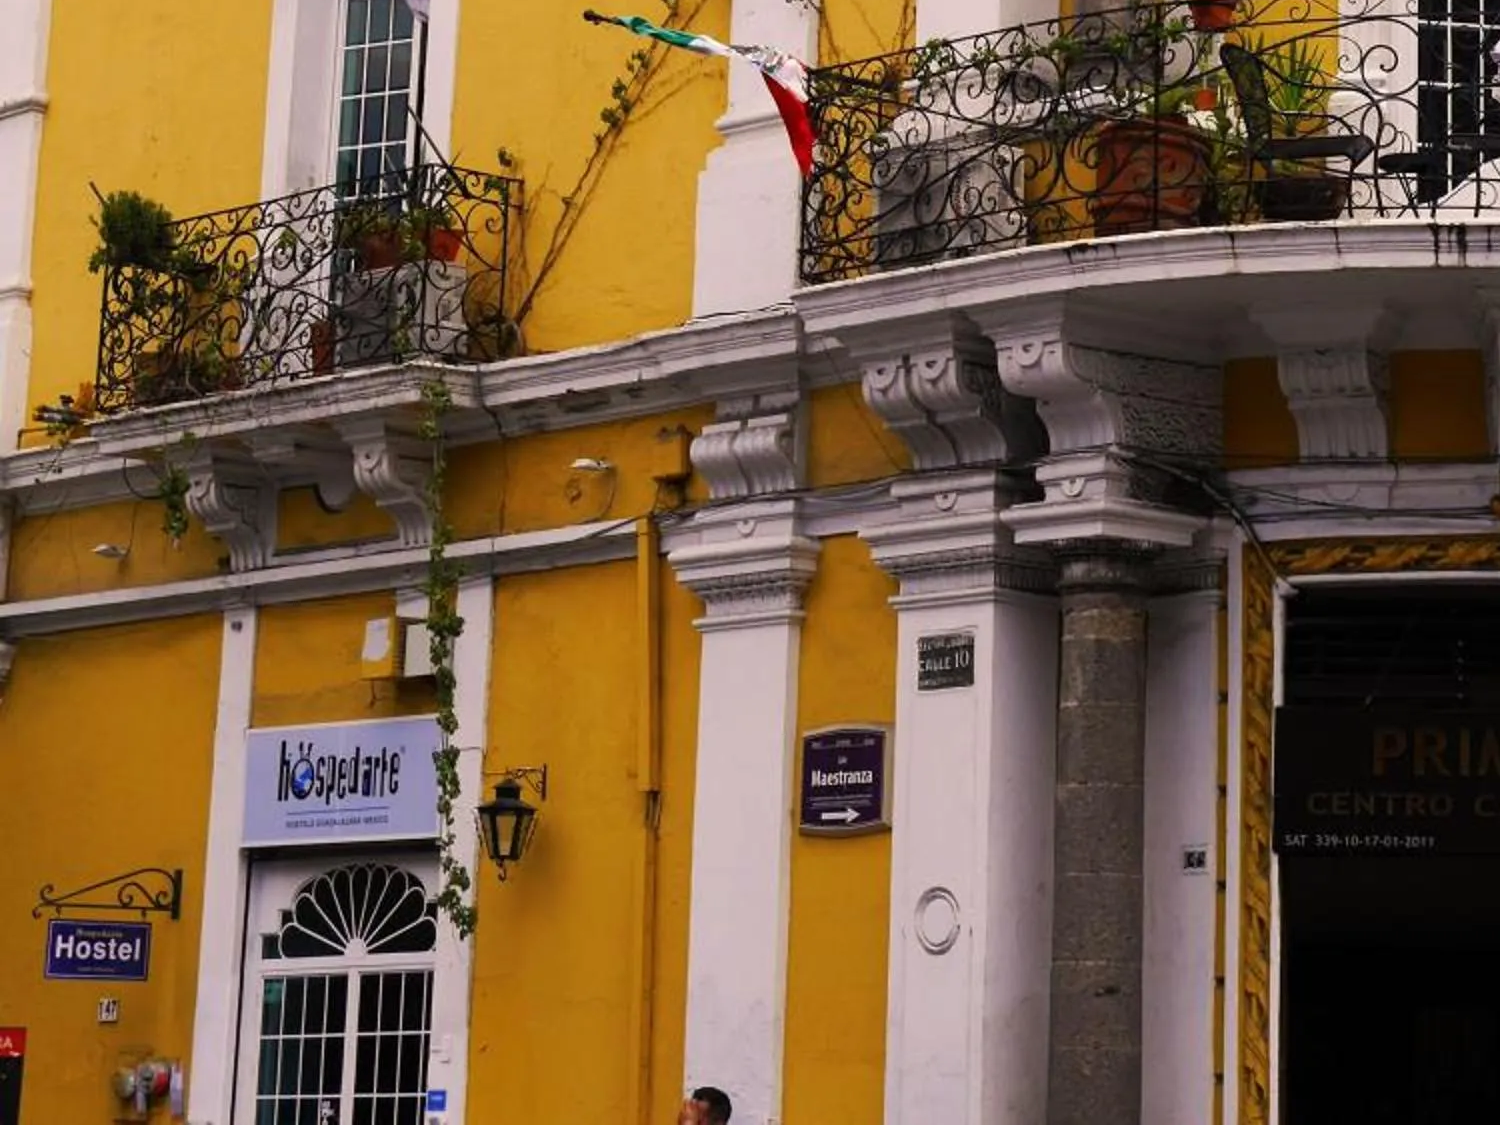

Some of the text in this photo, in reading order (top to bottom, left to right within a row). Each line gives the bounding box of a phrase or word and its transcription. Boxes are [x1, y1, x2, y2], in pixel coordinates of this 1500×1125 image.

[955, 650, 970, 668] 10
[811, 769, 873, 787] Maestranza
[1306, 792, 1454, 818] CENTRO
[1284, 834, 1307, 848] SAT
[55, 935, 141, 961] Hostel
